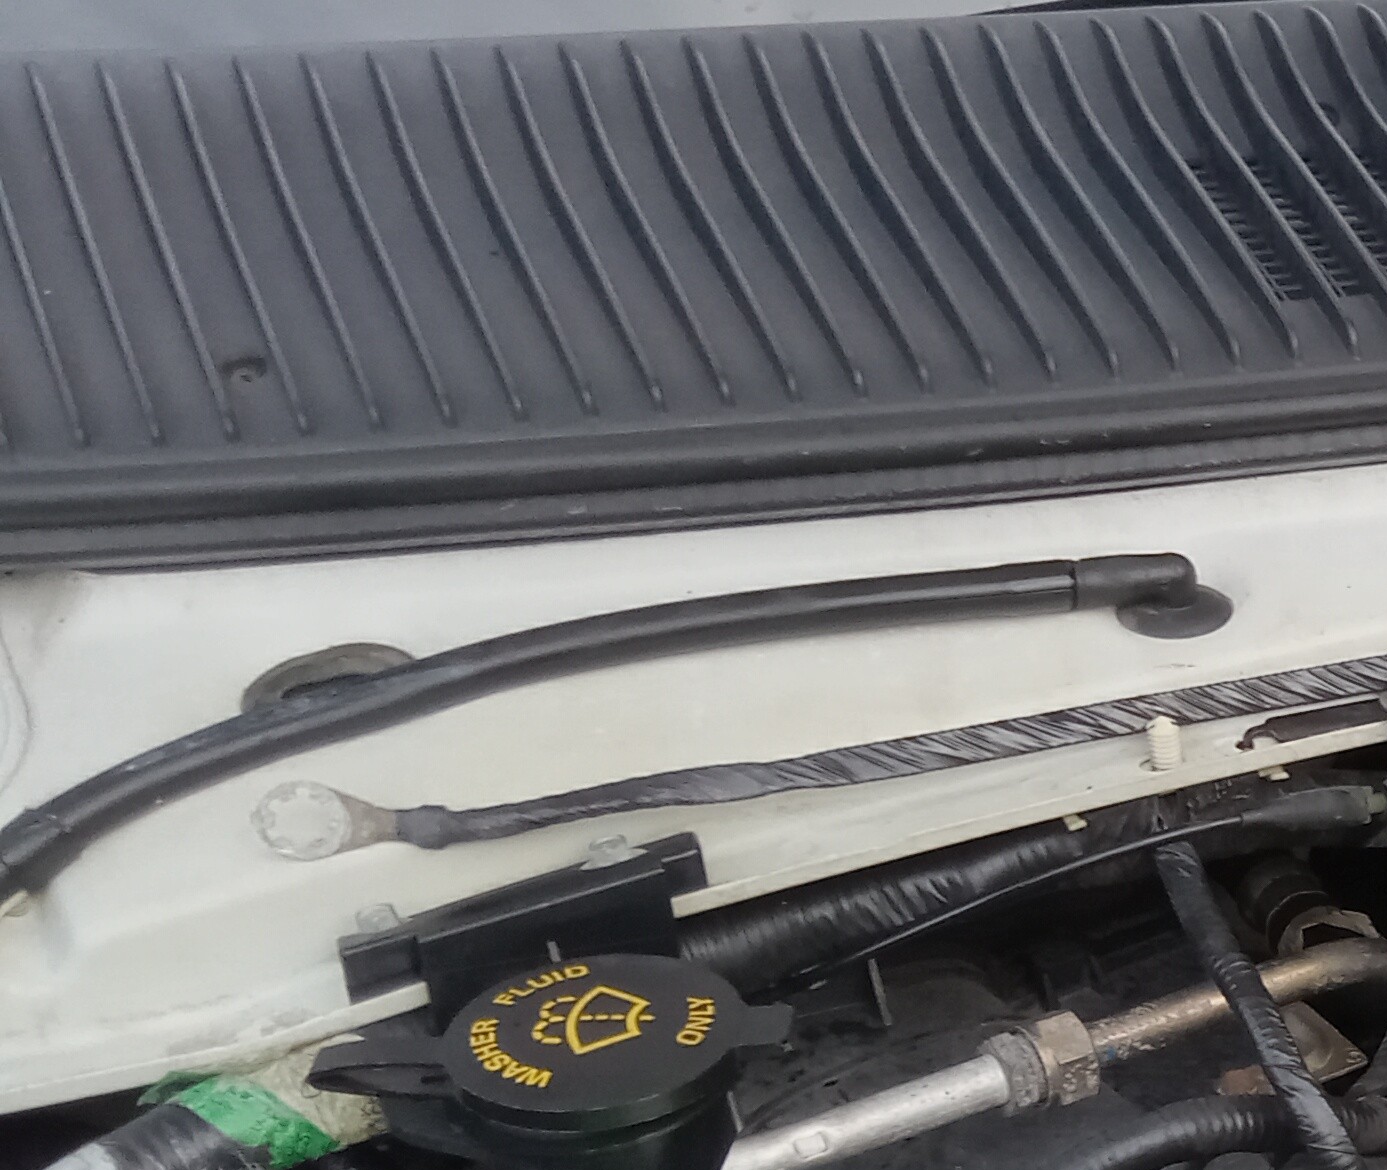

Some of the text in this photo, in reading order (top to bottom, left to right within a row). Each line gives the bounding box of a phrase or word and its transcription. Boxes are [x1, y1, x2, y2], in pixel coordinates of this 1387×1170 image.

[469, 964, 717, 1088] WASHER FLUID ONLY
